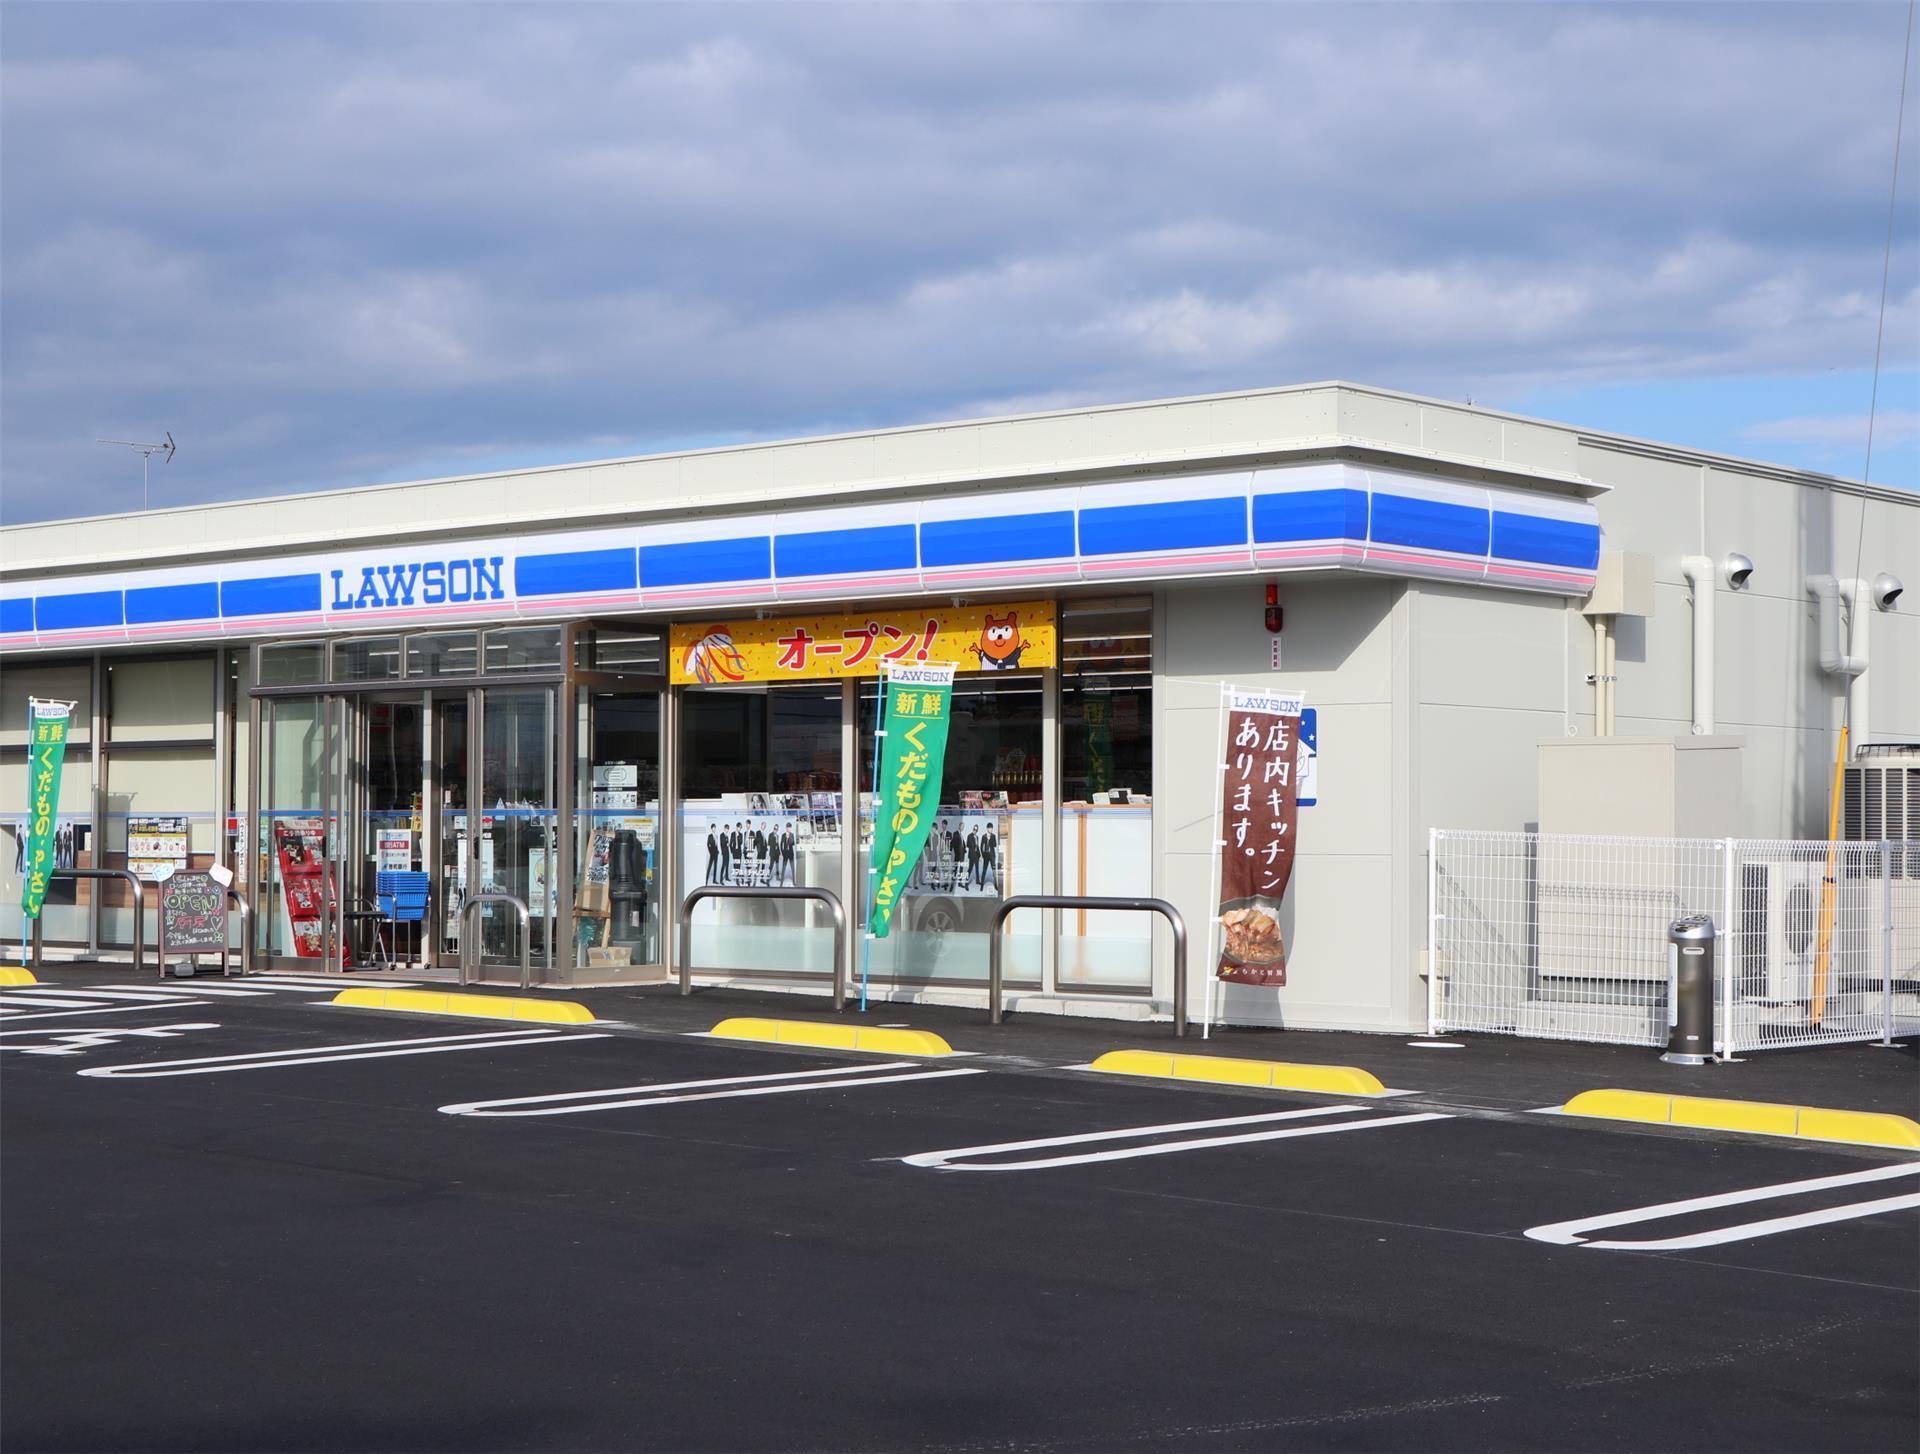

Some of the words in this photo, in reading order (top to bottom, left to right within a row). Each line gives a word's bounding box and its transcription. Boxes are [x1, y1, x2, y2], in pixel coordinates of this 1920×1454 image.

[330, 556, 505, 611] LAWSON
[778, 619, 938, 670] オープン!
[891, 669, 950, 683] LAWSON
[37, 706, 68, 716] LAWSON
[896, 692, 942, 716] 新鮮
[1234, 696, 1301, 713] LAWSON
[38, 724, 64, 742] 新鮮
[1232, 716, 1260, 857] あります。
[1261, 719, 1291, 889] 店内キッチン
